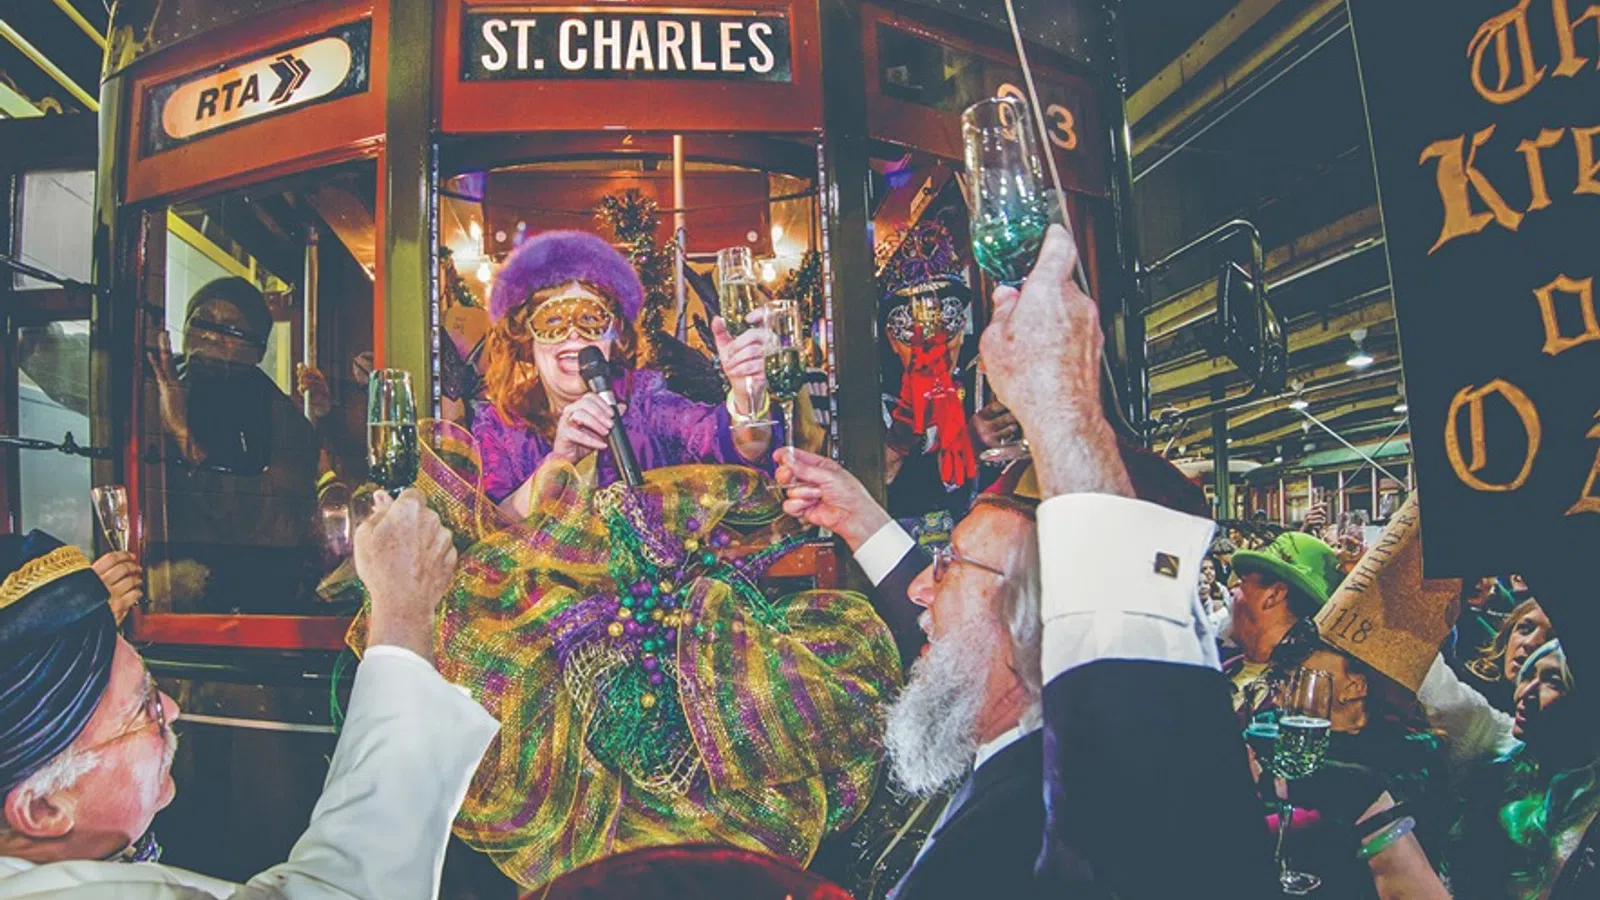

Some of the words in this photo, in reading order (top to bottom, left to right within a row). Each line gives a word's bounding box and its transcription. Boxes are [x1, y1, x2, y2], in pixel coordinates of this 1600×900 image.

[481, 19, 544, 71] ST.
[559, 19, 775, 73] CHARLES
[196, 73, 260, 121] RTA
